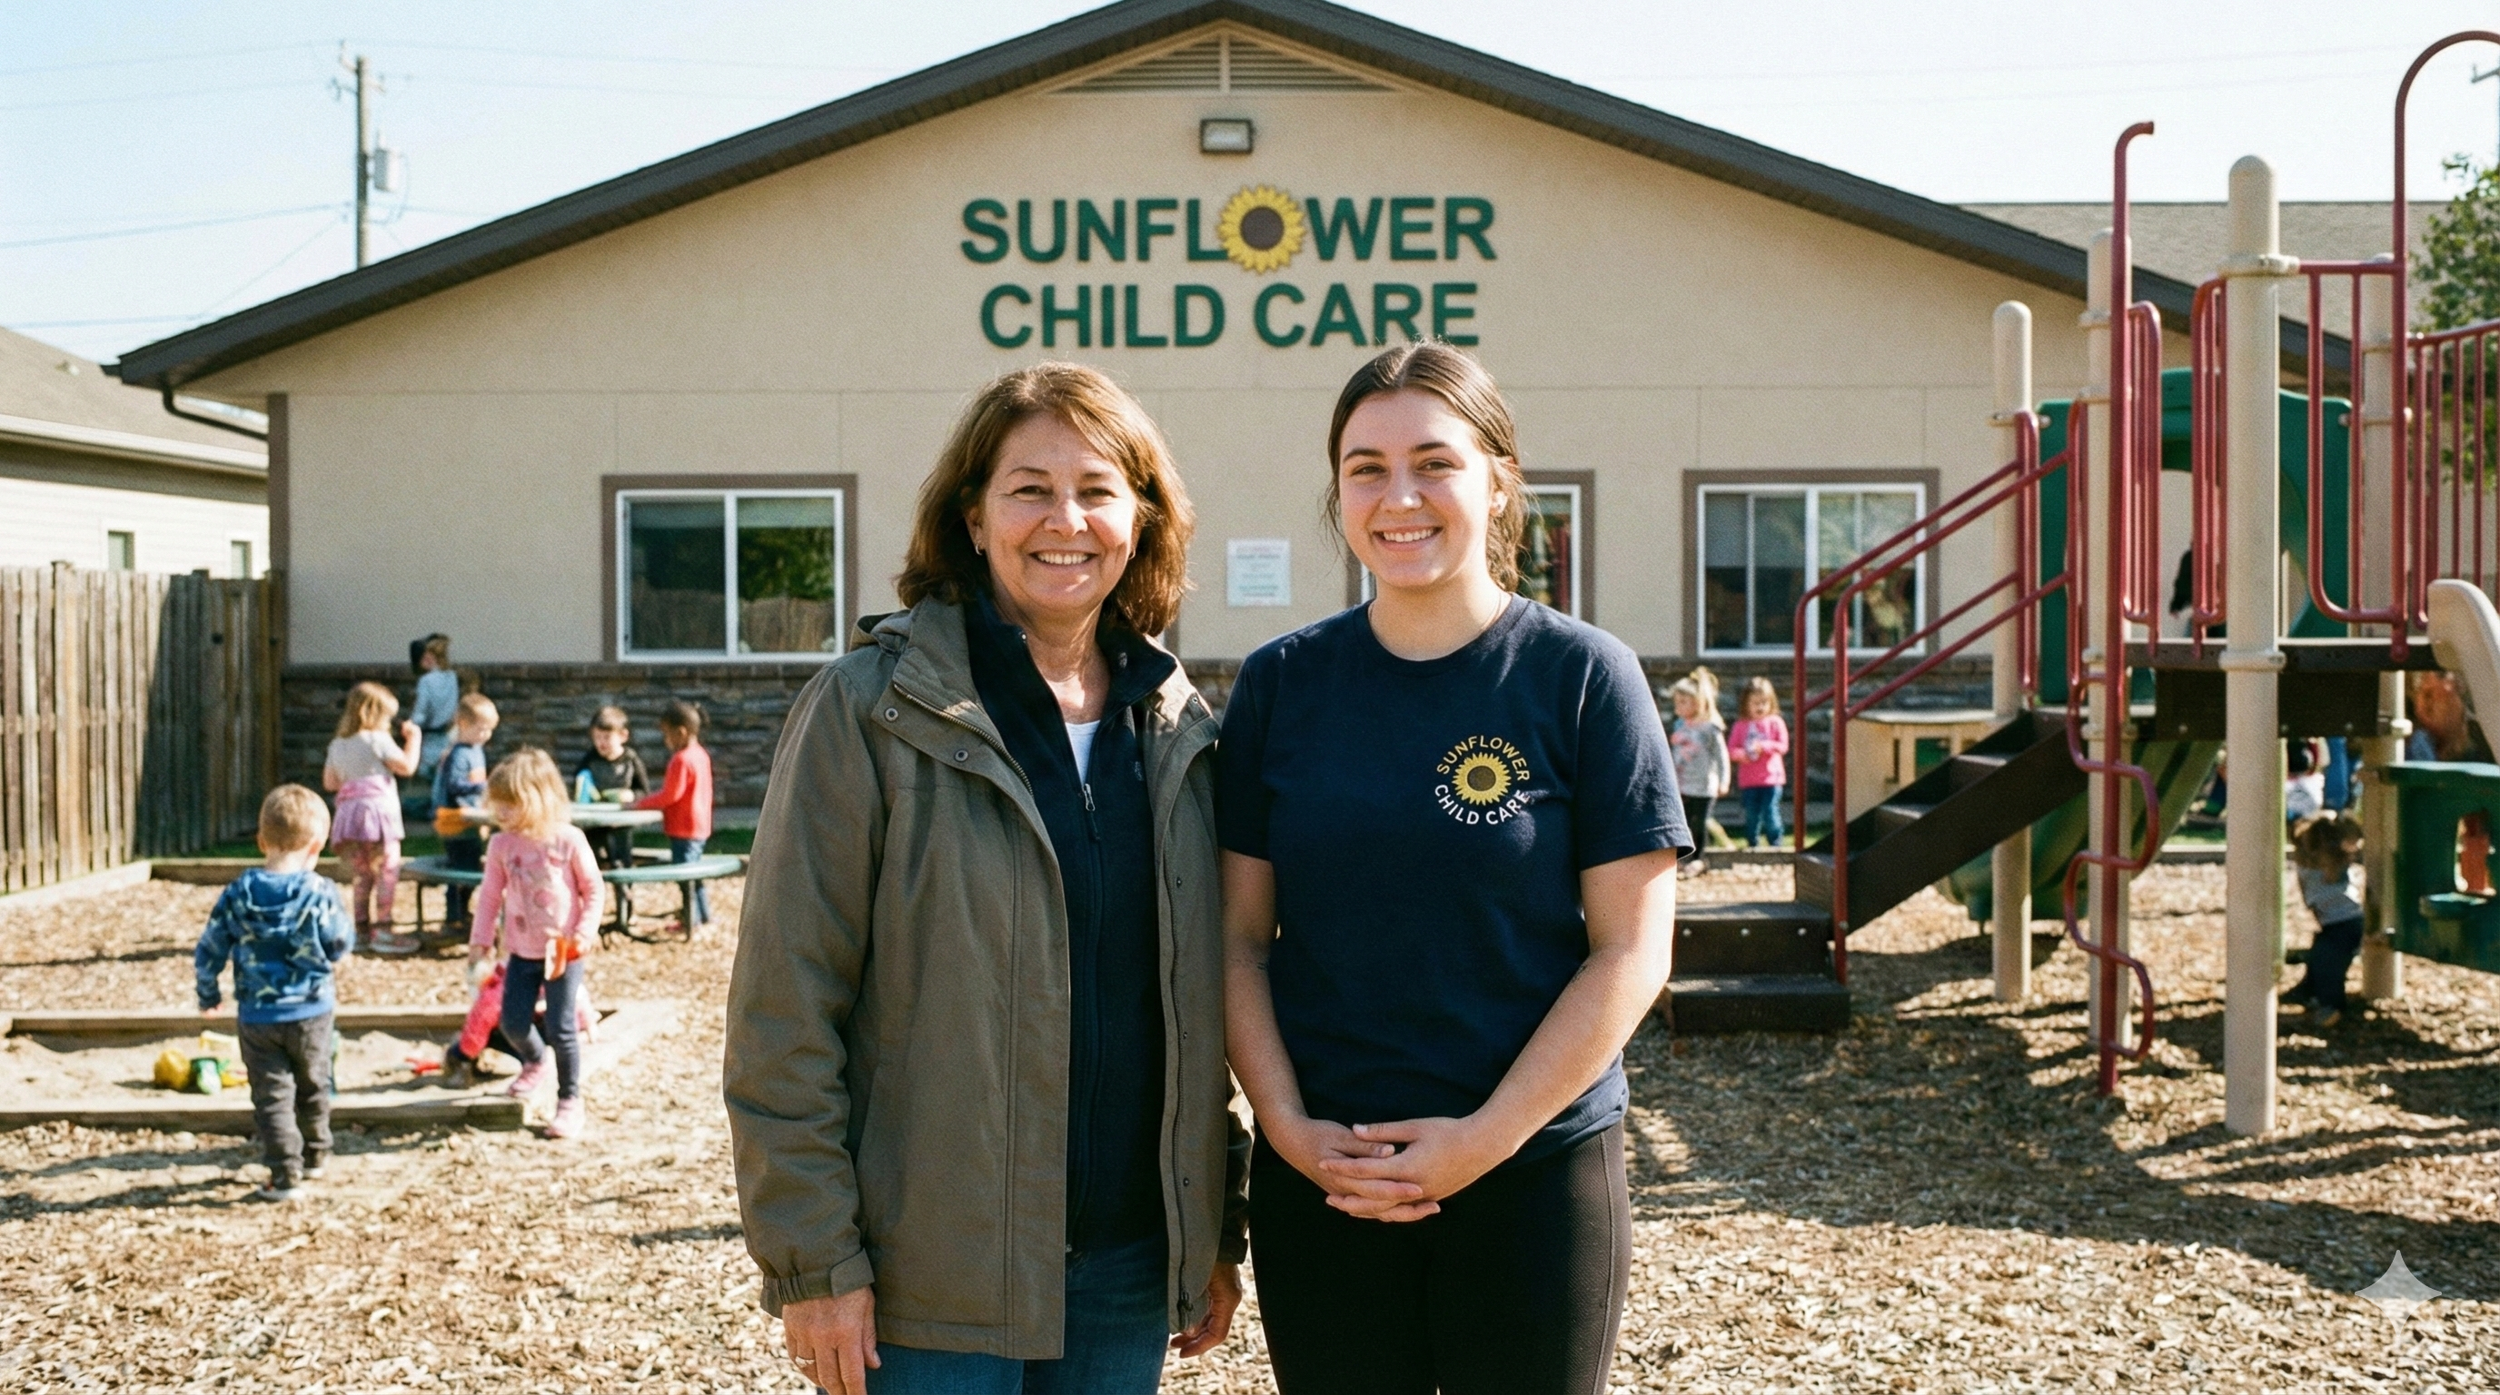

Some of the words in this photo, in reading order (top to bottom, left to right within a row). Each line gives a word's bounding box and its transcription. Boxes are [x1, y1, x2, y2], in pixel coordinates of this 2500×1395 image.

[979, 283, 1227, 349] CHILD
[1253, 283, 1480, 348] CARE
[1436, 735, 1530, 782] SUNFLOWER
[1434, 784, 1480, 826] CHILD
[1485, 789, 1531, 826] CARE
